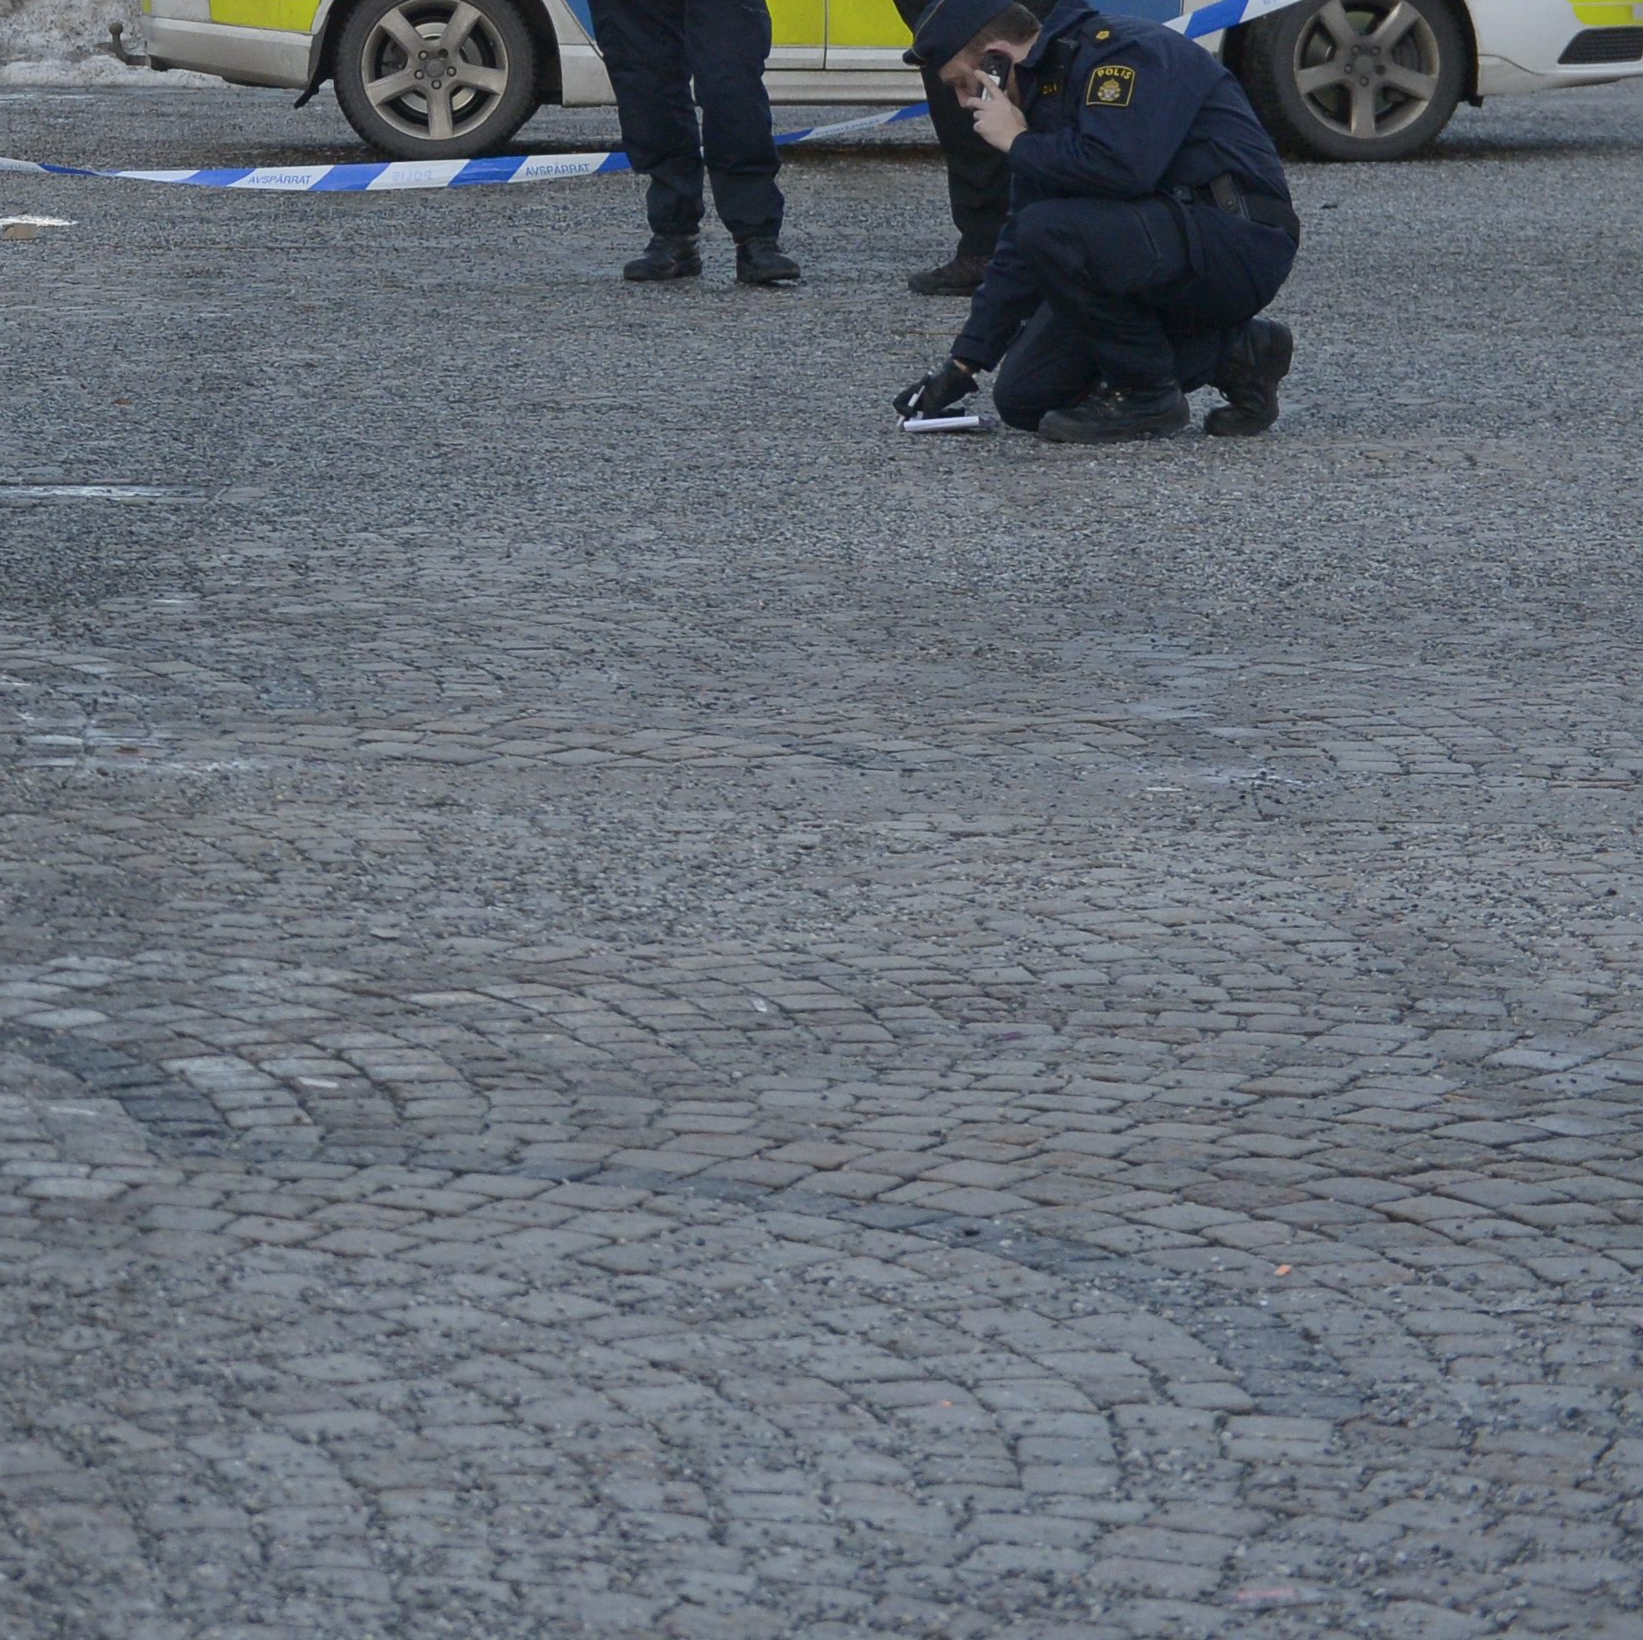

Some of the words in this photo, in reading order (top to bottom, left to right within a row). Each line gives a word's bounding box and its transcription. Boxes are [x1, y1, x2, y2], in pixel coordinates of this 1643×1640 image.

[1098, 68, 1132, 79] POLIS
[525, 161, 591, 176] AVSPÄRRAT
[247, 172, 312, 185] AVSPÄRRAT
